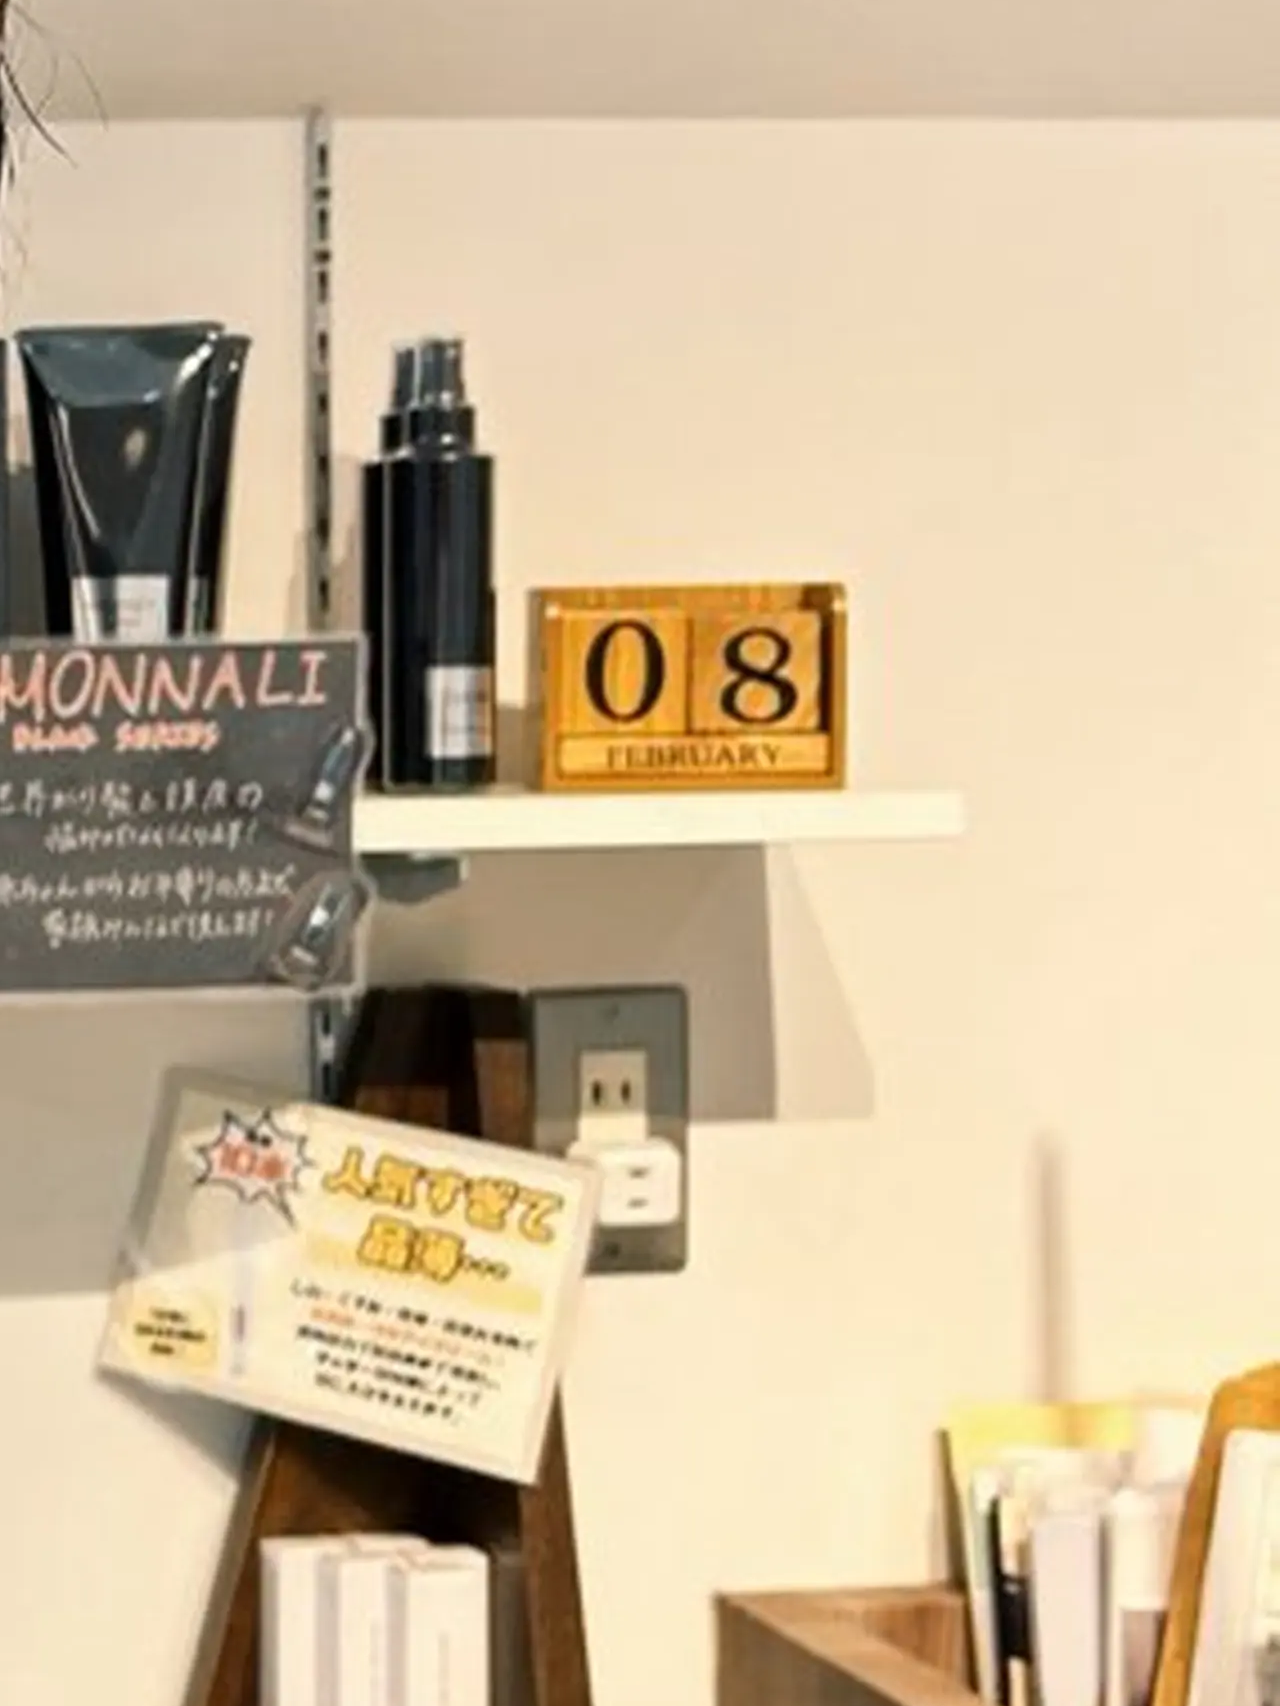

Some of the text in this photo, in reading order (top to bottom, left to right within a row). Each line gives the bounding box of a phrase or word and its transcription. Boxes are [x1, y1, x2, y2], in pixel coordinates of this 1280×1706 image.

[605, 743, 782, 769] FEBRUARY
[323, 1145, 565, 1243] 人気すぎて
